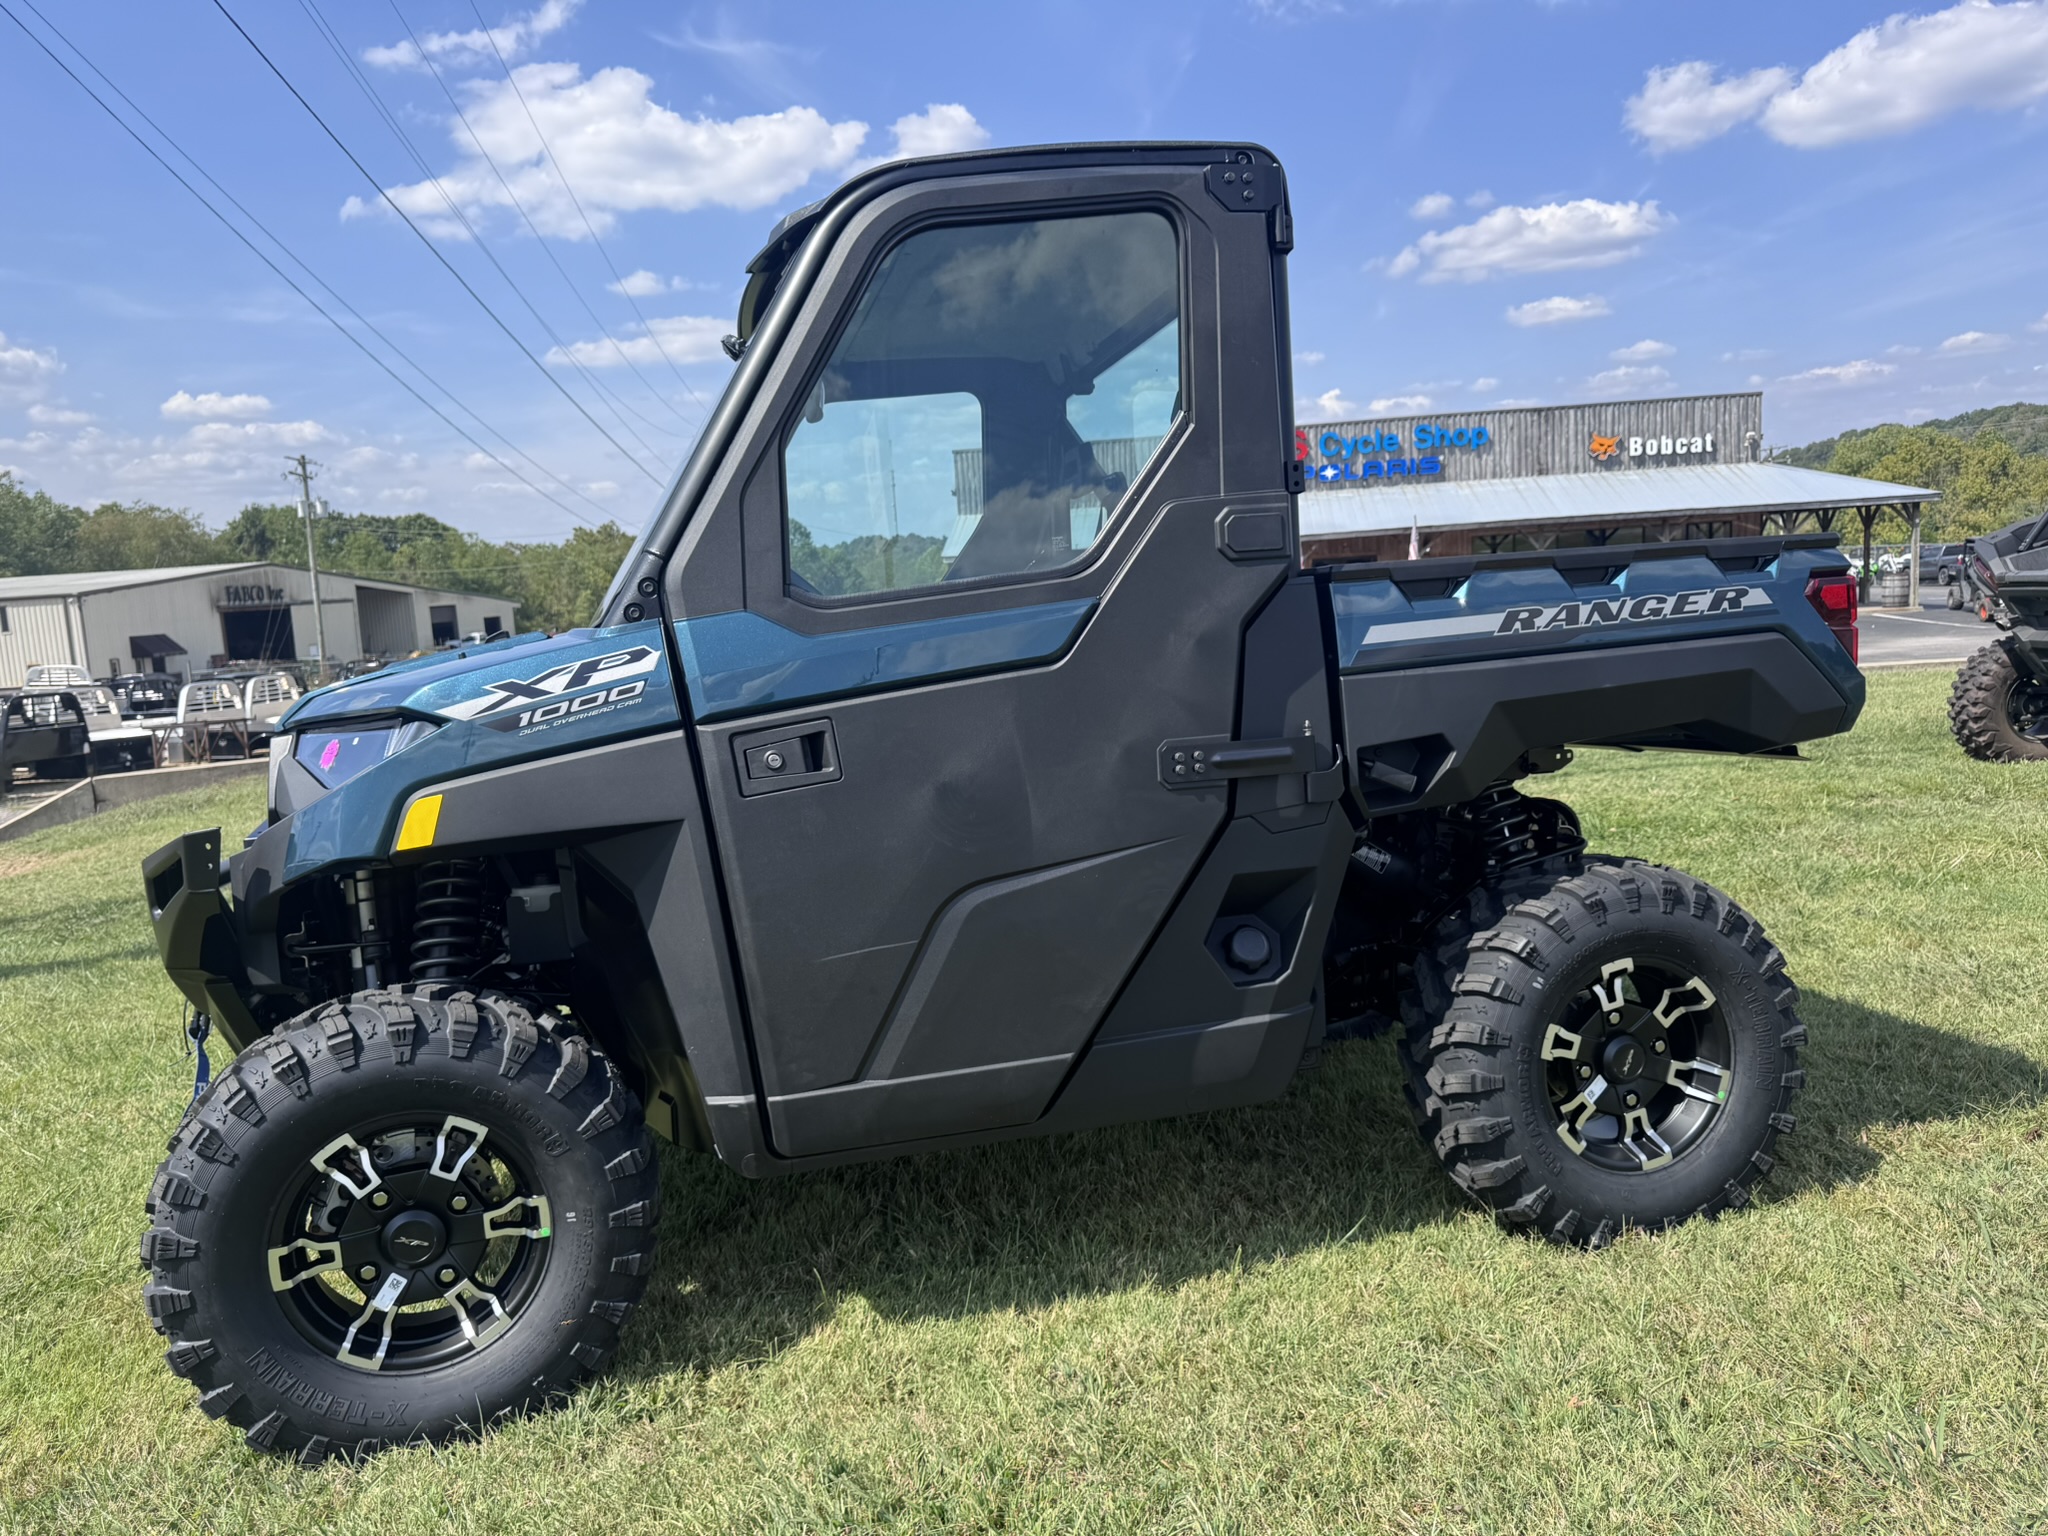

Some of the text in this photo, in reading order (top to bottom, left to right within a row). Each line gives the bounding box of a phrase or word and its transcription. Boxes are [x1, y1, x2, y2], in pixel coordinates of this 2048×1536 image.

[1319, 427, 1400, 459] Cycle
[1413, 423, 1489, 451] Shop
[1628, 433, 1714, 457] Bobcat
[1494, 586, 1751, 636] RANGER
[468, 647, 655, 717] XP
[518, 680, 646, 728] 1000
[518, 697, 643, 737] DUAL OVERHEAD CAM
[244, 1345, 410, 1427] X-TERRAIN
